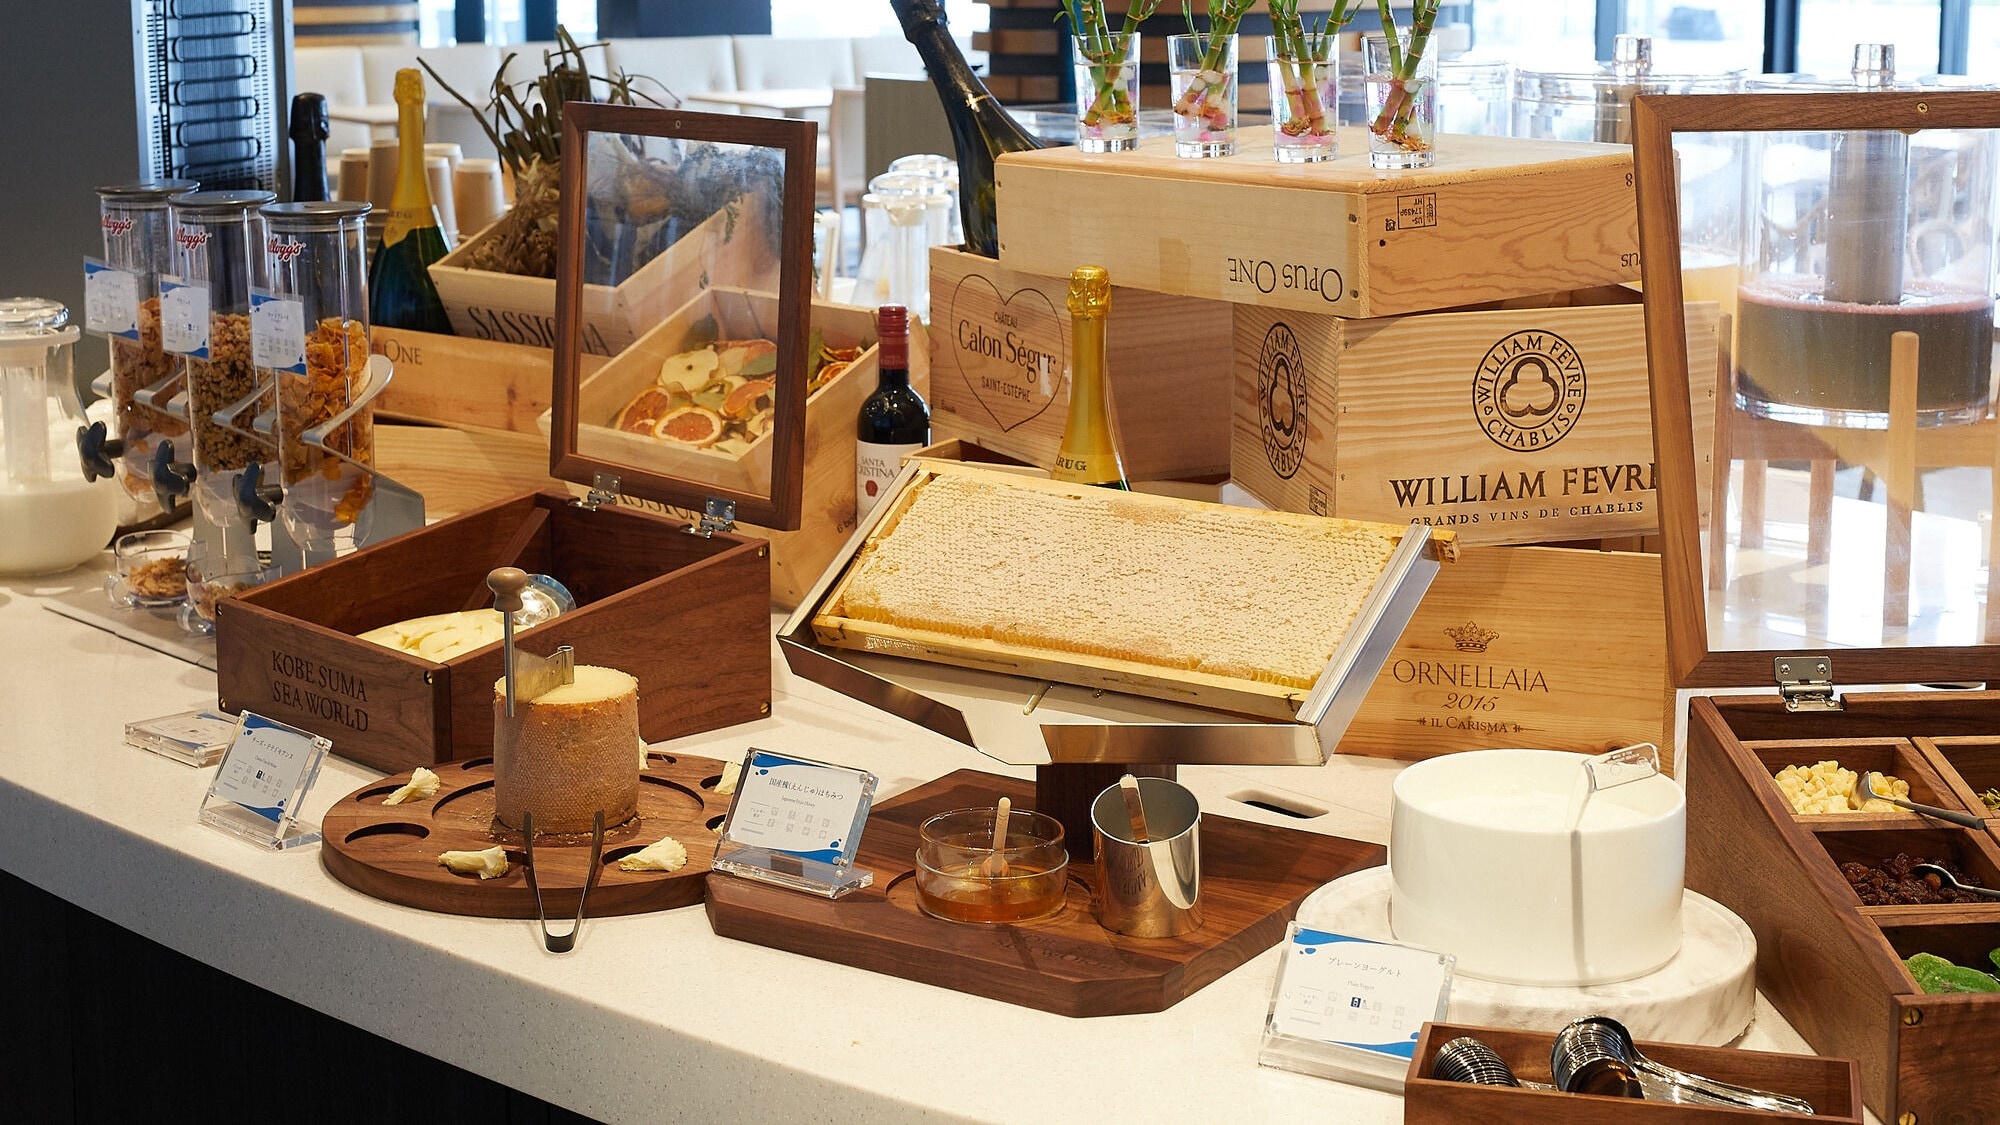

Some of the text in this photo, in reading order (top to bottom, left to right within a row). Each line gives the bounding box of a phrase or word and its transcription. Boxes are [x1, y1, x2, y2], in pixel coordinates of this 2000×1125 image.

[102, 213, 133, 235] llogg's
[176, 227, 207, 250] llogg's
[268, 237, 301, 261] llogg's
[958, 319, 1056, 384] Calon Ségur
[1260, 329, 1305, 426] WILLIAM FEVRE
[1477, 334, 1582, 405] WILLIAM FEVRE
[1487, 412, 1571, 447] CHABLIS
[860, 456, 886, 468] SANTA
[1263, 424, 1301, 472] CHABLIS
[857, 463, 895, 478] RISTINA
[1389, 470, 1547, 509] WILLIAM
[1410, 501, 1644, 527] GRANDS VINS DE CHABLIS
[272, 650, 369, 703] KOBE SUMA
[1393, 659, 1549, 693] ORNELLAIA
[273, 680, 369, 732] SEA WORLD
[1441, 692, 1500, 712] 2015
[1431, 716, 1508, 733] IL CARISMA
